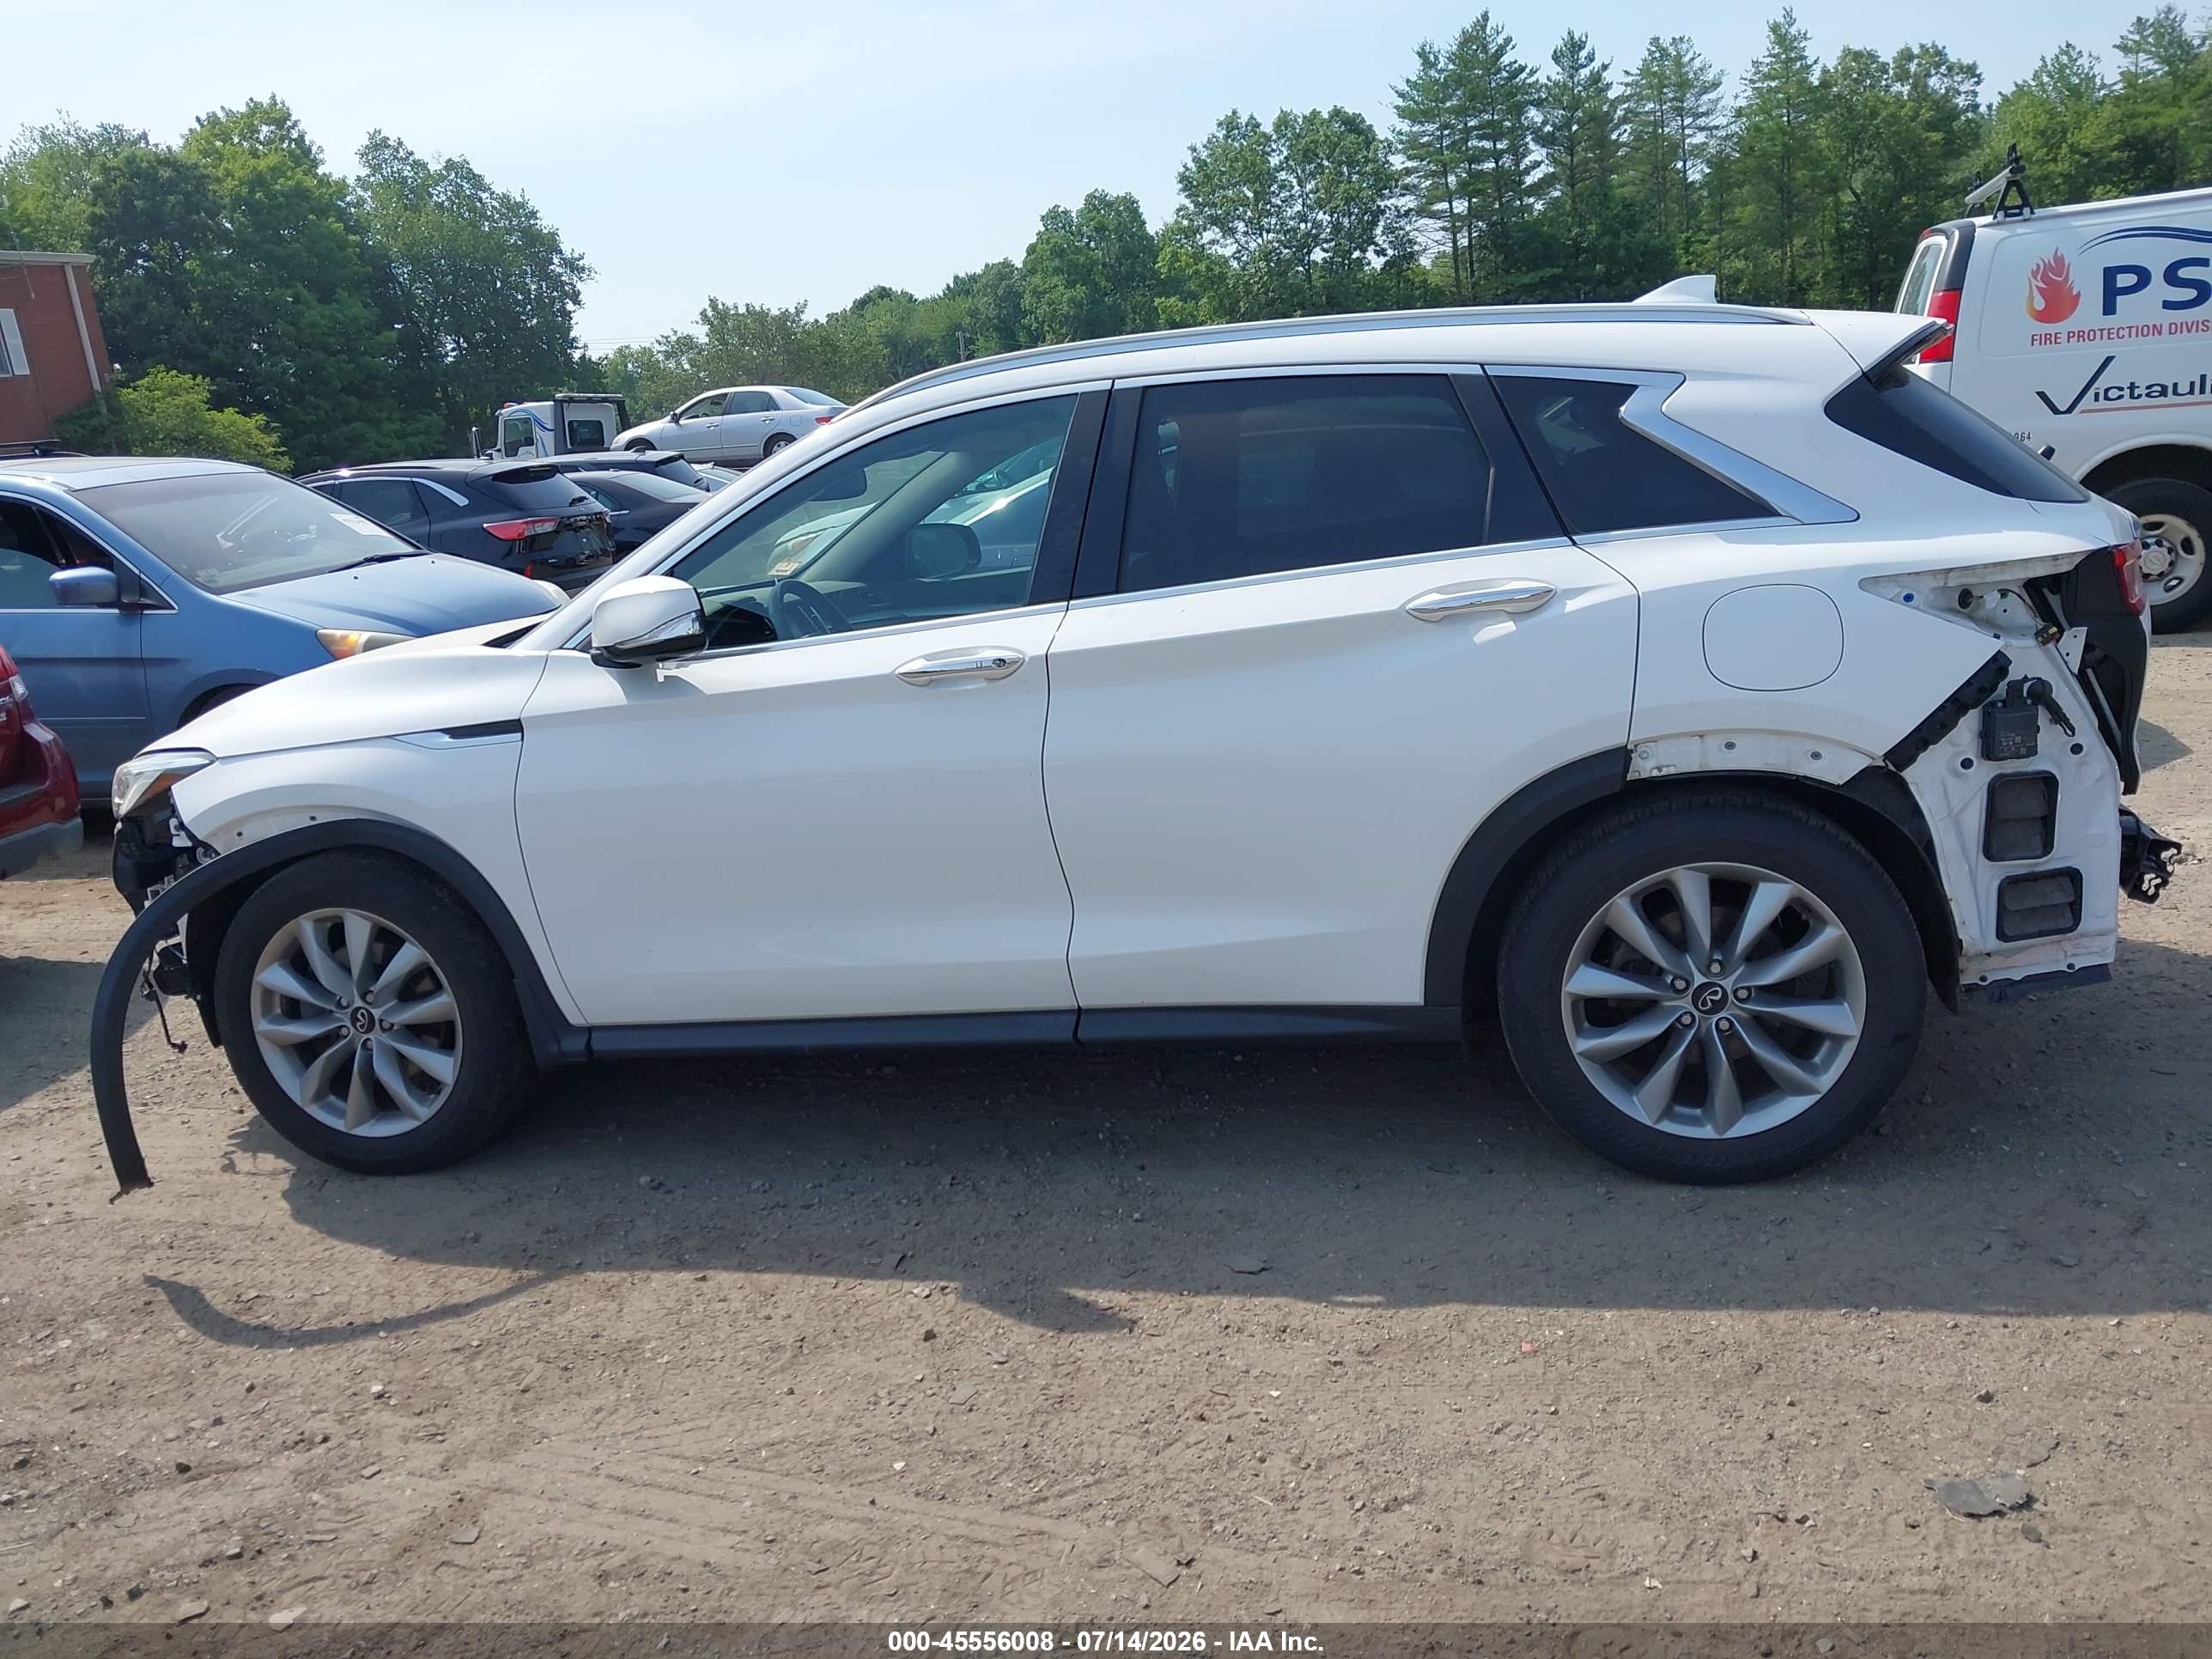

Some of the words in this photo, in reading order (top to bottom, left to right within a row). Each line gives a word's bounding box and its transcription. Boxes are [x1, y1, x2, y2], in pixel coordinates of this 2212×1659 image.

[2031, 331, 2062, 346] FIRE
[2067, 324, 2163, 343] PROTECTION
[2168, 319, 2212, 335] DIVIS
